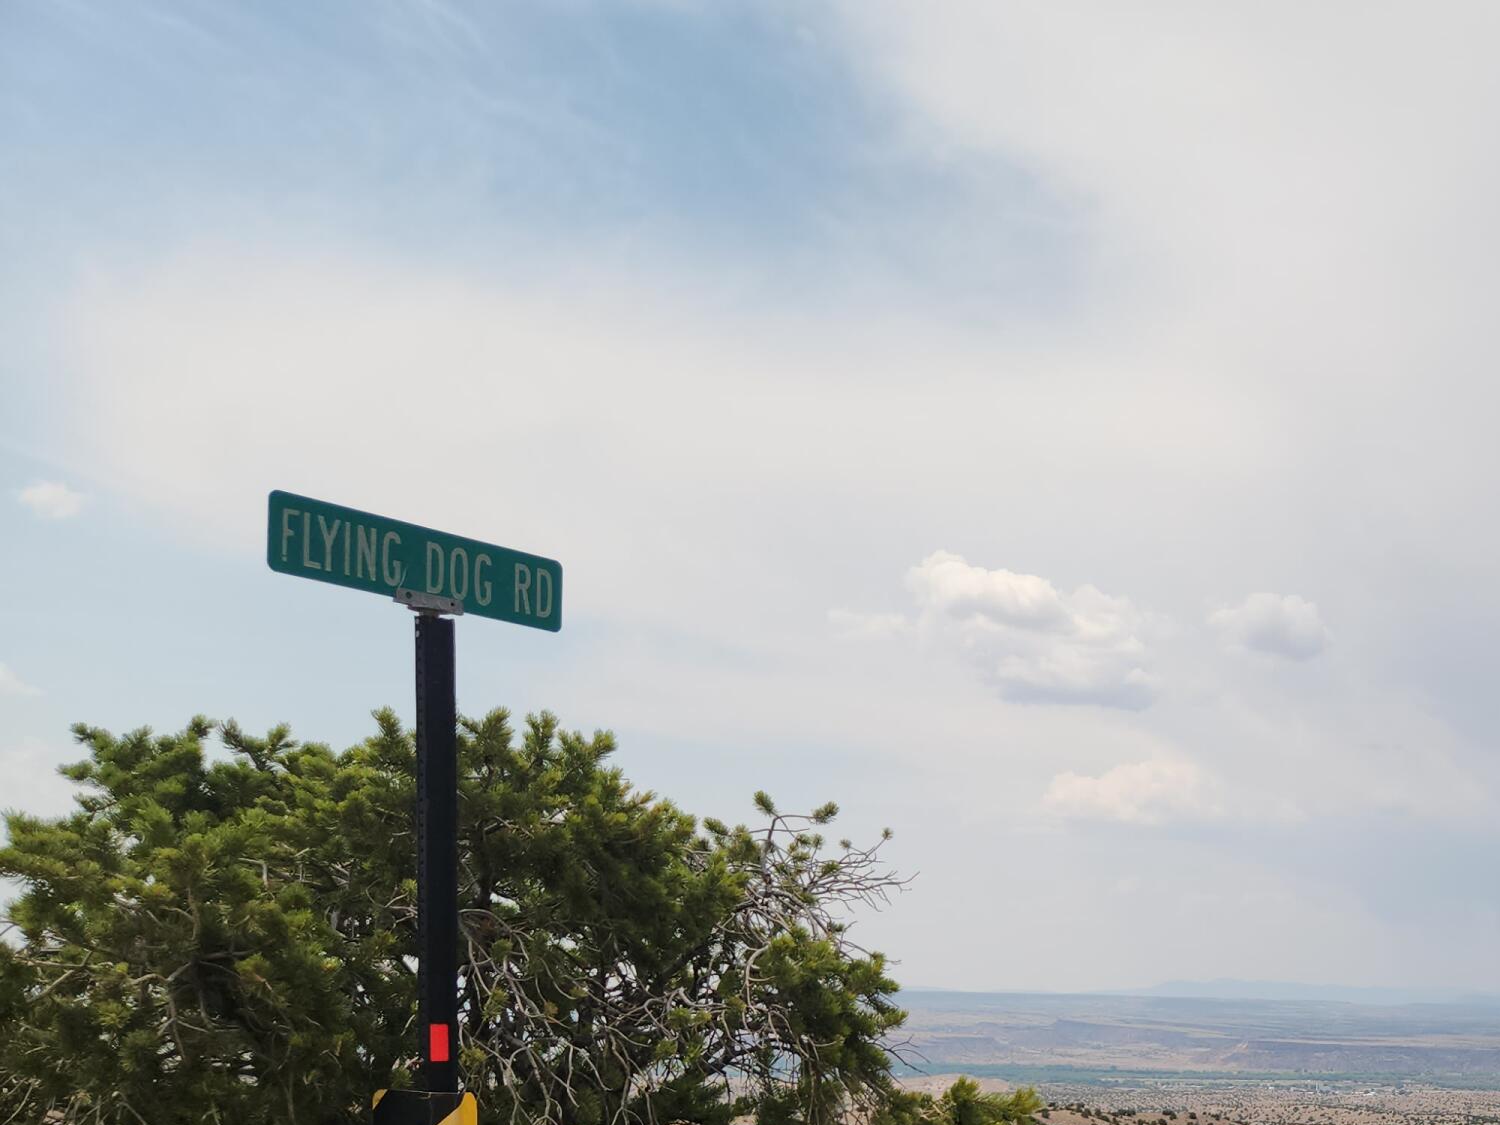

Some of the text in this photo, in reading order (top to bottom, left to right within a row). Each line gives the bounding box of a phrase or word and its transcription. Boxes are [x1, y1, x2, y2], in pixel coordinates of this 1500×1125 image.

[281, 508, 553, 618] FLYING DOG RD
